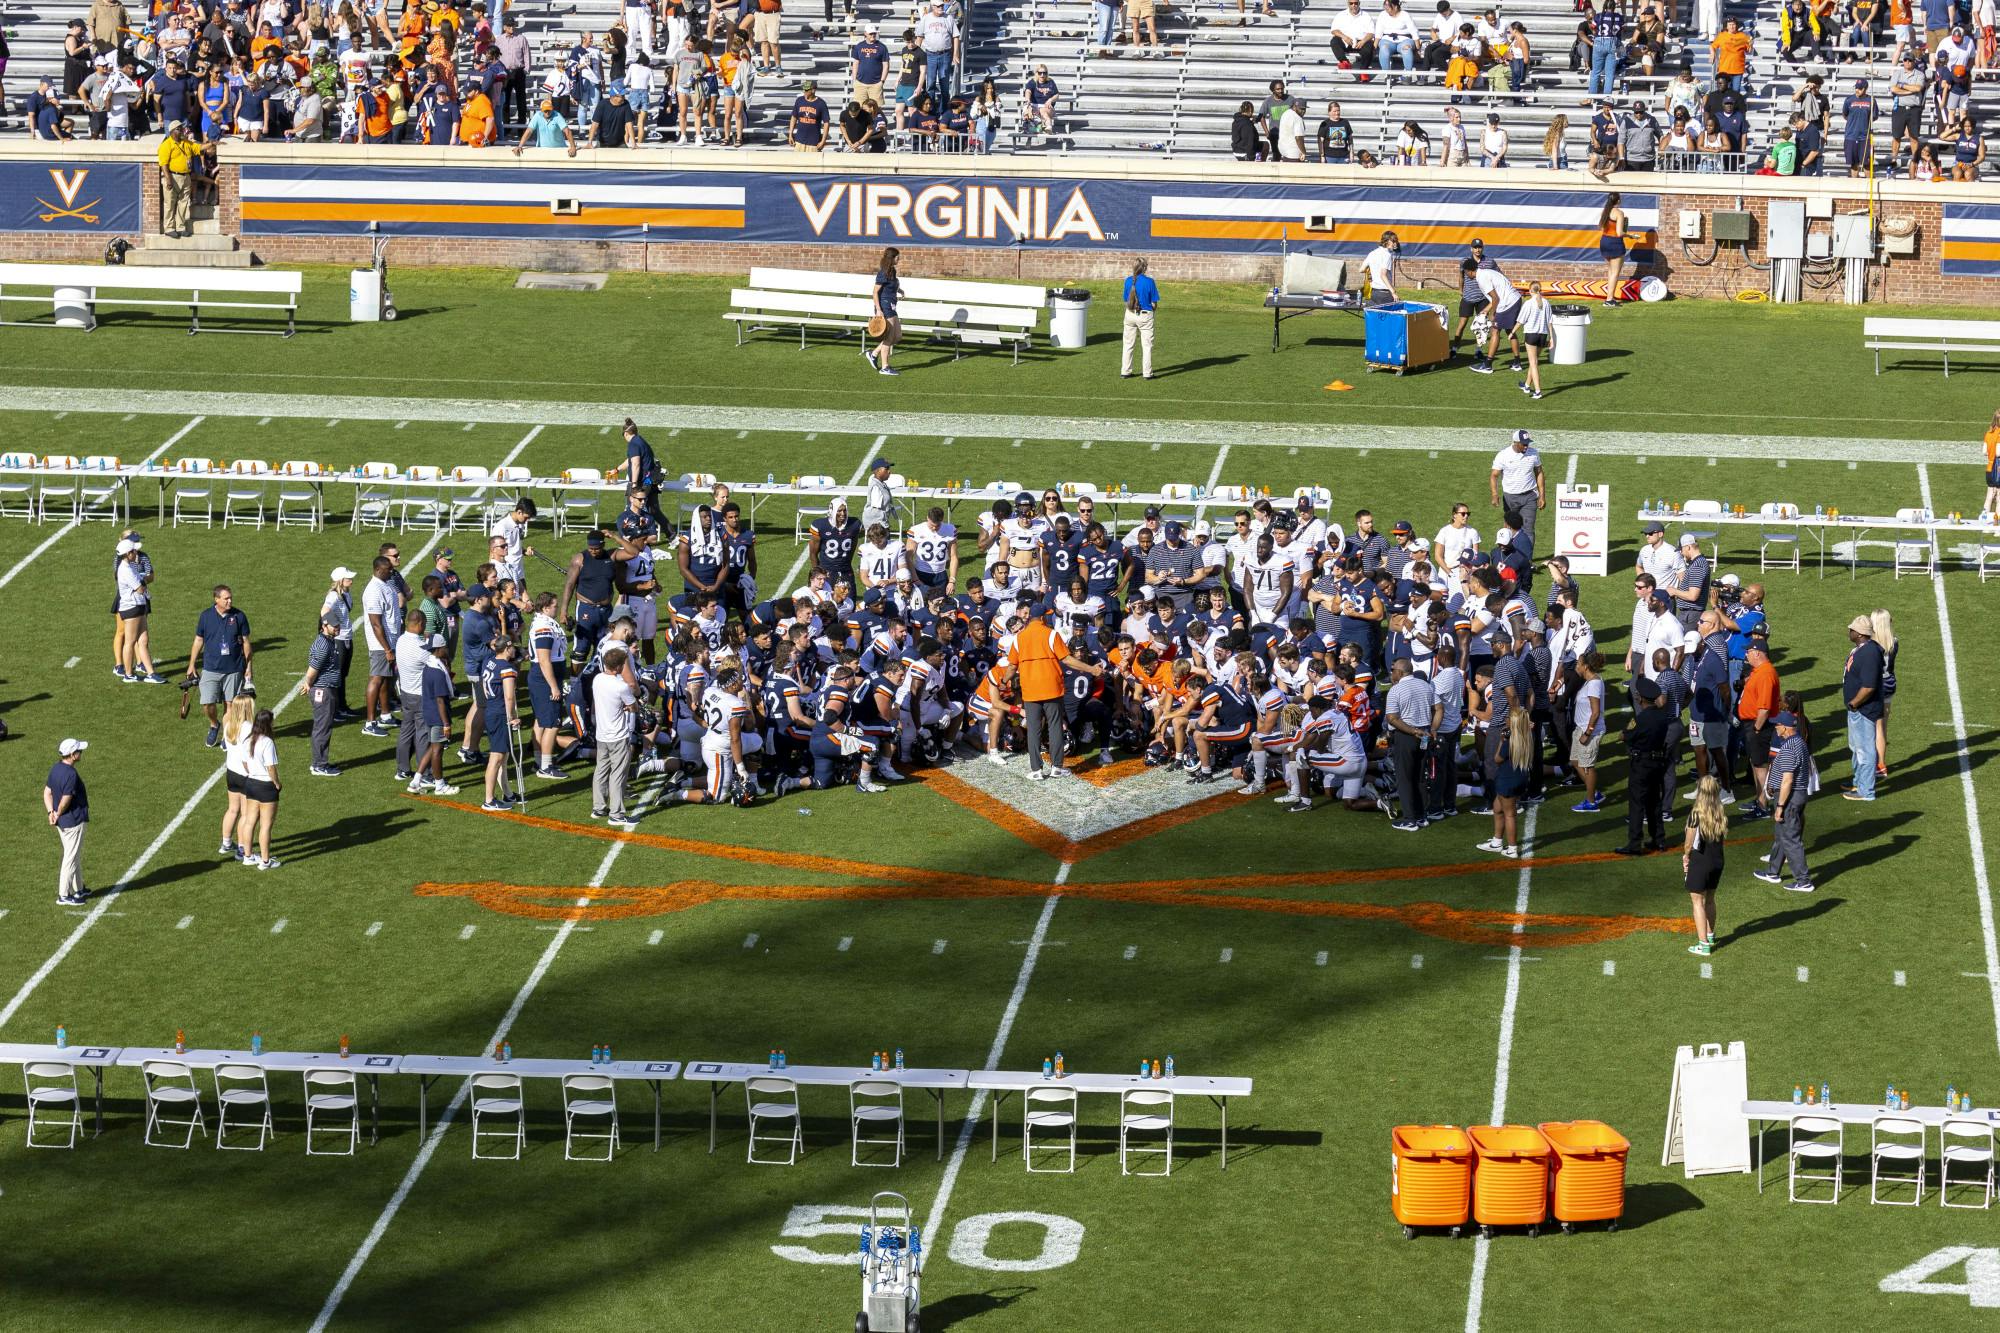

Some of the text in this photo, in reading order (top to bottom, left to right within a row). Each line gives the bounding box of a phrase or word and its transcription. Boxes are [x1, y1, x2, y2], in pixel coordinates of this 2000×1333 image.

[48, 169, 89, 208] V
[790, 183, 1105, 240] VIRGINIA
[825, 539, 852, 559] 89
[1572, 531, 1590, 549] C
[921, 541, 948, 562] 33
[1055, 550, 1069, 571] 3
[872, 558, 892, 579] 41
[1090, 558, 1118, 580] 22
[1254, 569, 1273, 591] 71
[1074, 676, 1088, 699] 0
